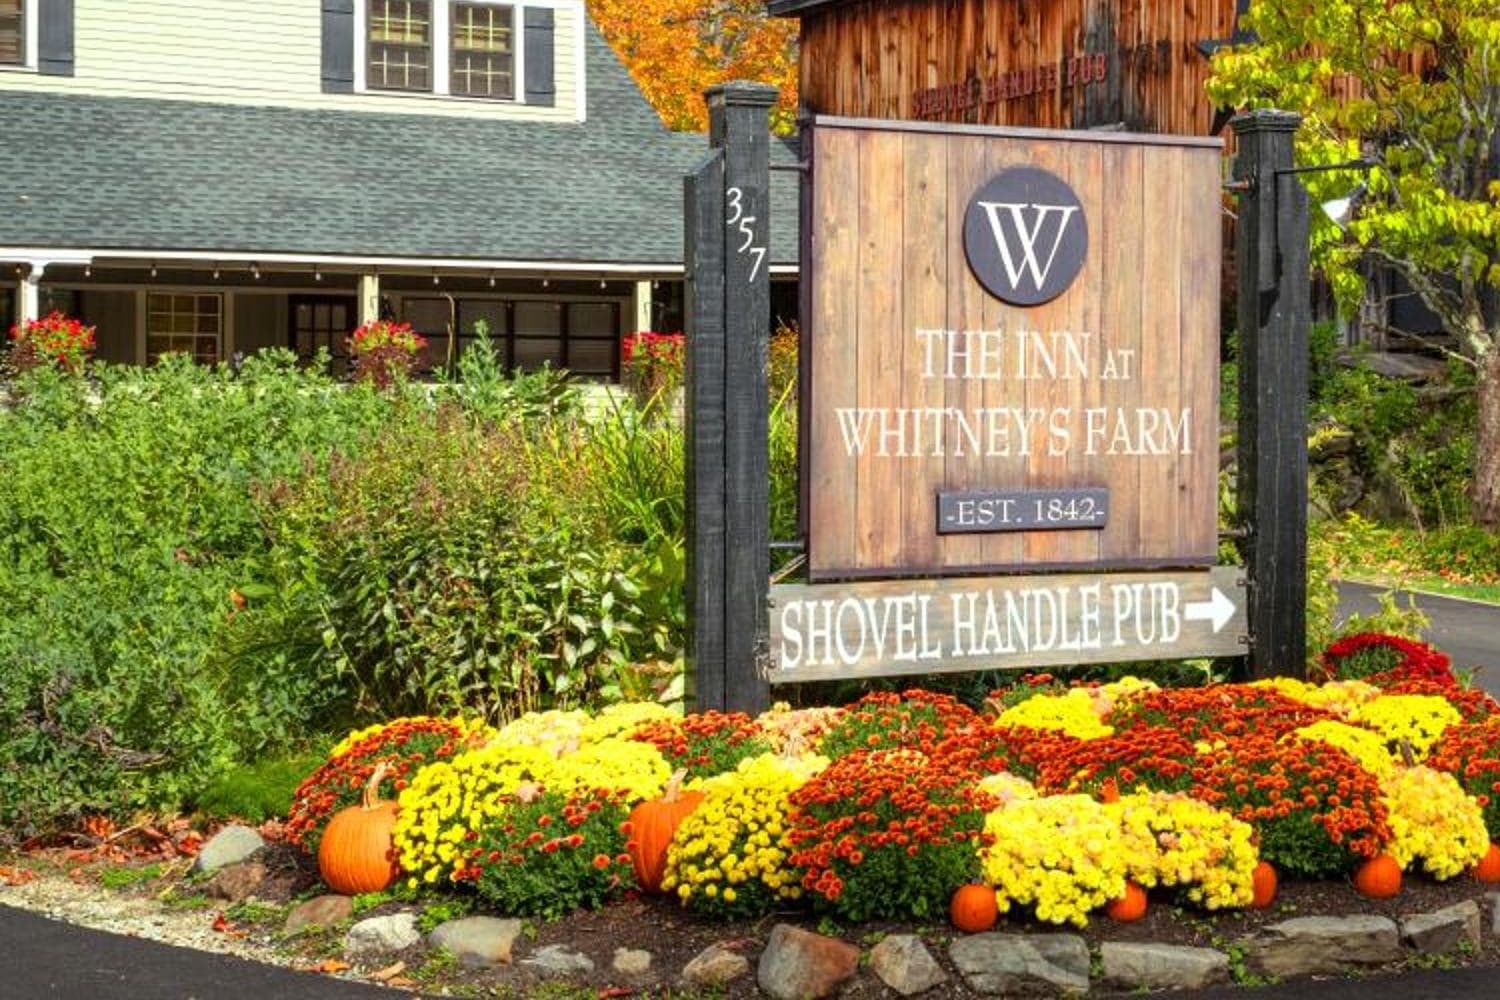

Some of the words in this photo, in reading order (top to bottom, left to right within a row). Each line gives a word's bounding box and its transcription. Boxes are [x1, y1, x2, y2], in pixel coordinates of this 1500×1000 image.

[1067, 52, 1107, 87] PUB
[726, 186, 767, 283] 357
[977, 200, 1080, 292] W
[915, 327, 1002, 380] THE
[1015, 328, 1092, 380] INN
[1100, 349, 1135, 380] AT
[834, 406, 1071, 458] WHITNEY'S
[1084, 406, 1193, 456] FARM
[780, 592, 941, 671] SHOVEL
[951, 583, 1102, 657] HANDLE
[1111, 580, 1181, 646] PUB
